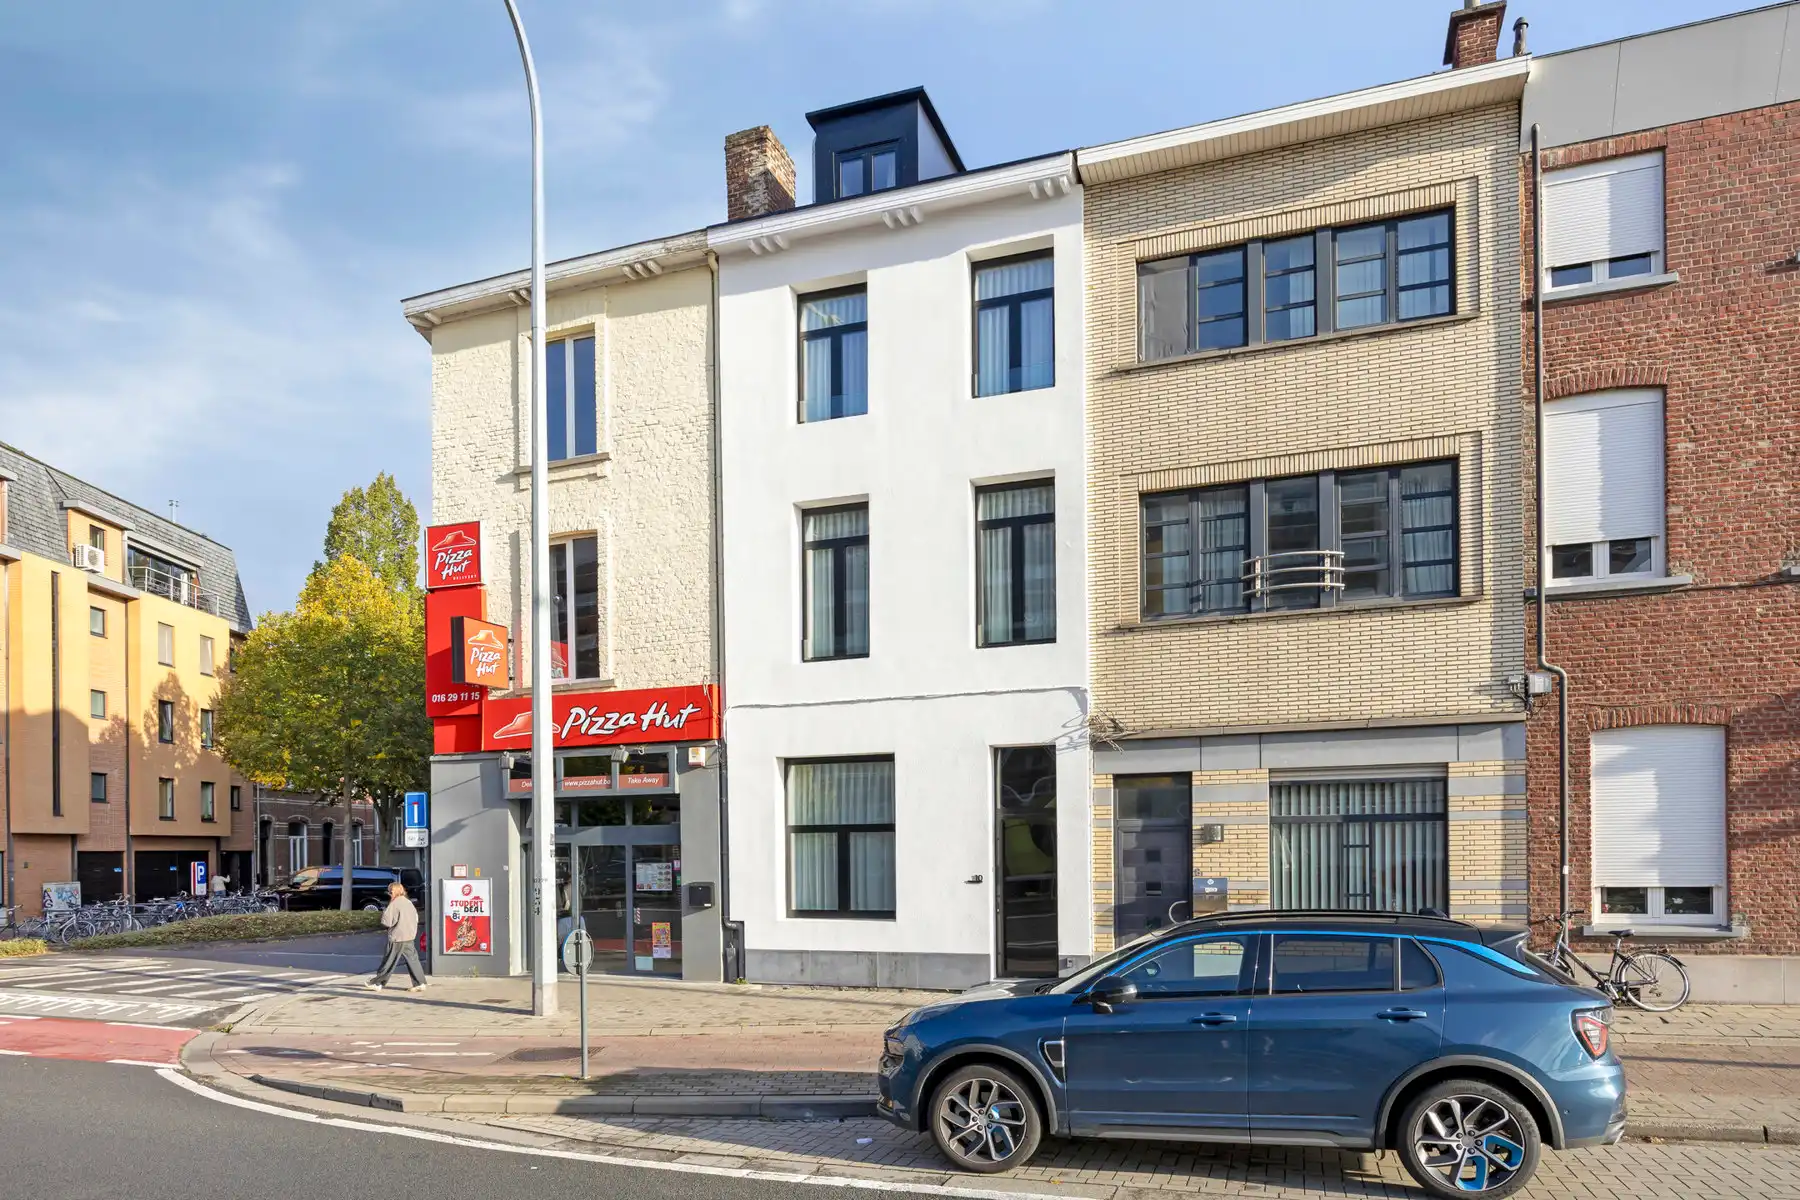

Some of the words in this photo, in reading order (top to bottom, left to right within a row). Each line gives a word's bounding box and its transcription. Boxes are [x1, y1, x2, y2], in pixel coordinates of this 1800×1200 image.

[434, 549, 473, 571] Pizza
[441, 564, 472, 580] Hut
[470, 646, 502, 665] Pizza
[475, 661, 501, 678] Hut
[431, 693, 447, 703] 016
[447, 692, 459, 702] 29
[460, 691, 469, 701] 11
[470, 691, 481, 700] 15
[560, 705, 638, 740] Pizza
[639, 701, 702, 732] Hut
[642, 776, 660, 785] Away
[197, 865, 205, 881] P
[450, 900, 484, 908] STUDENT
